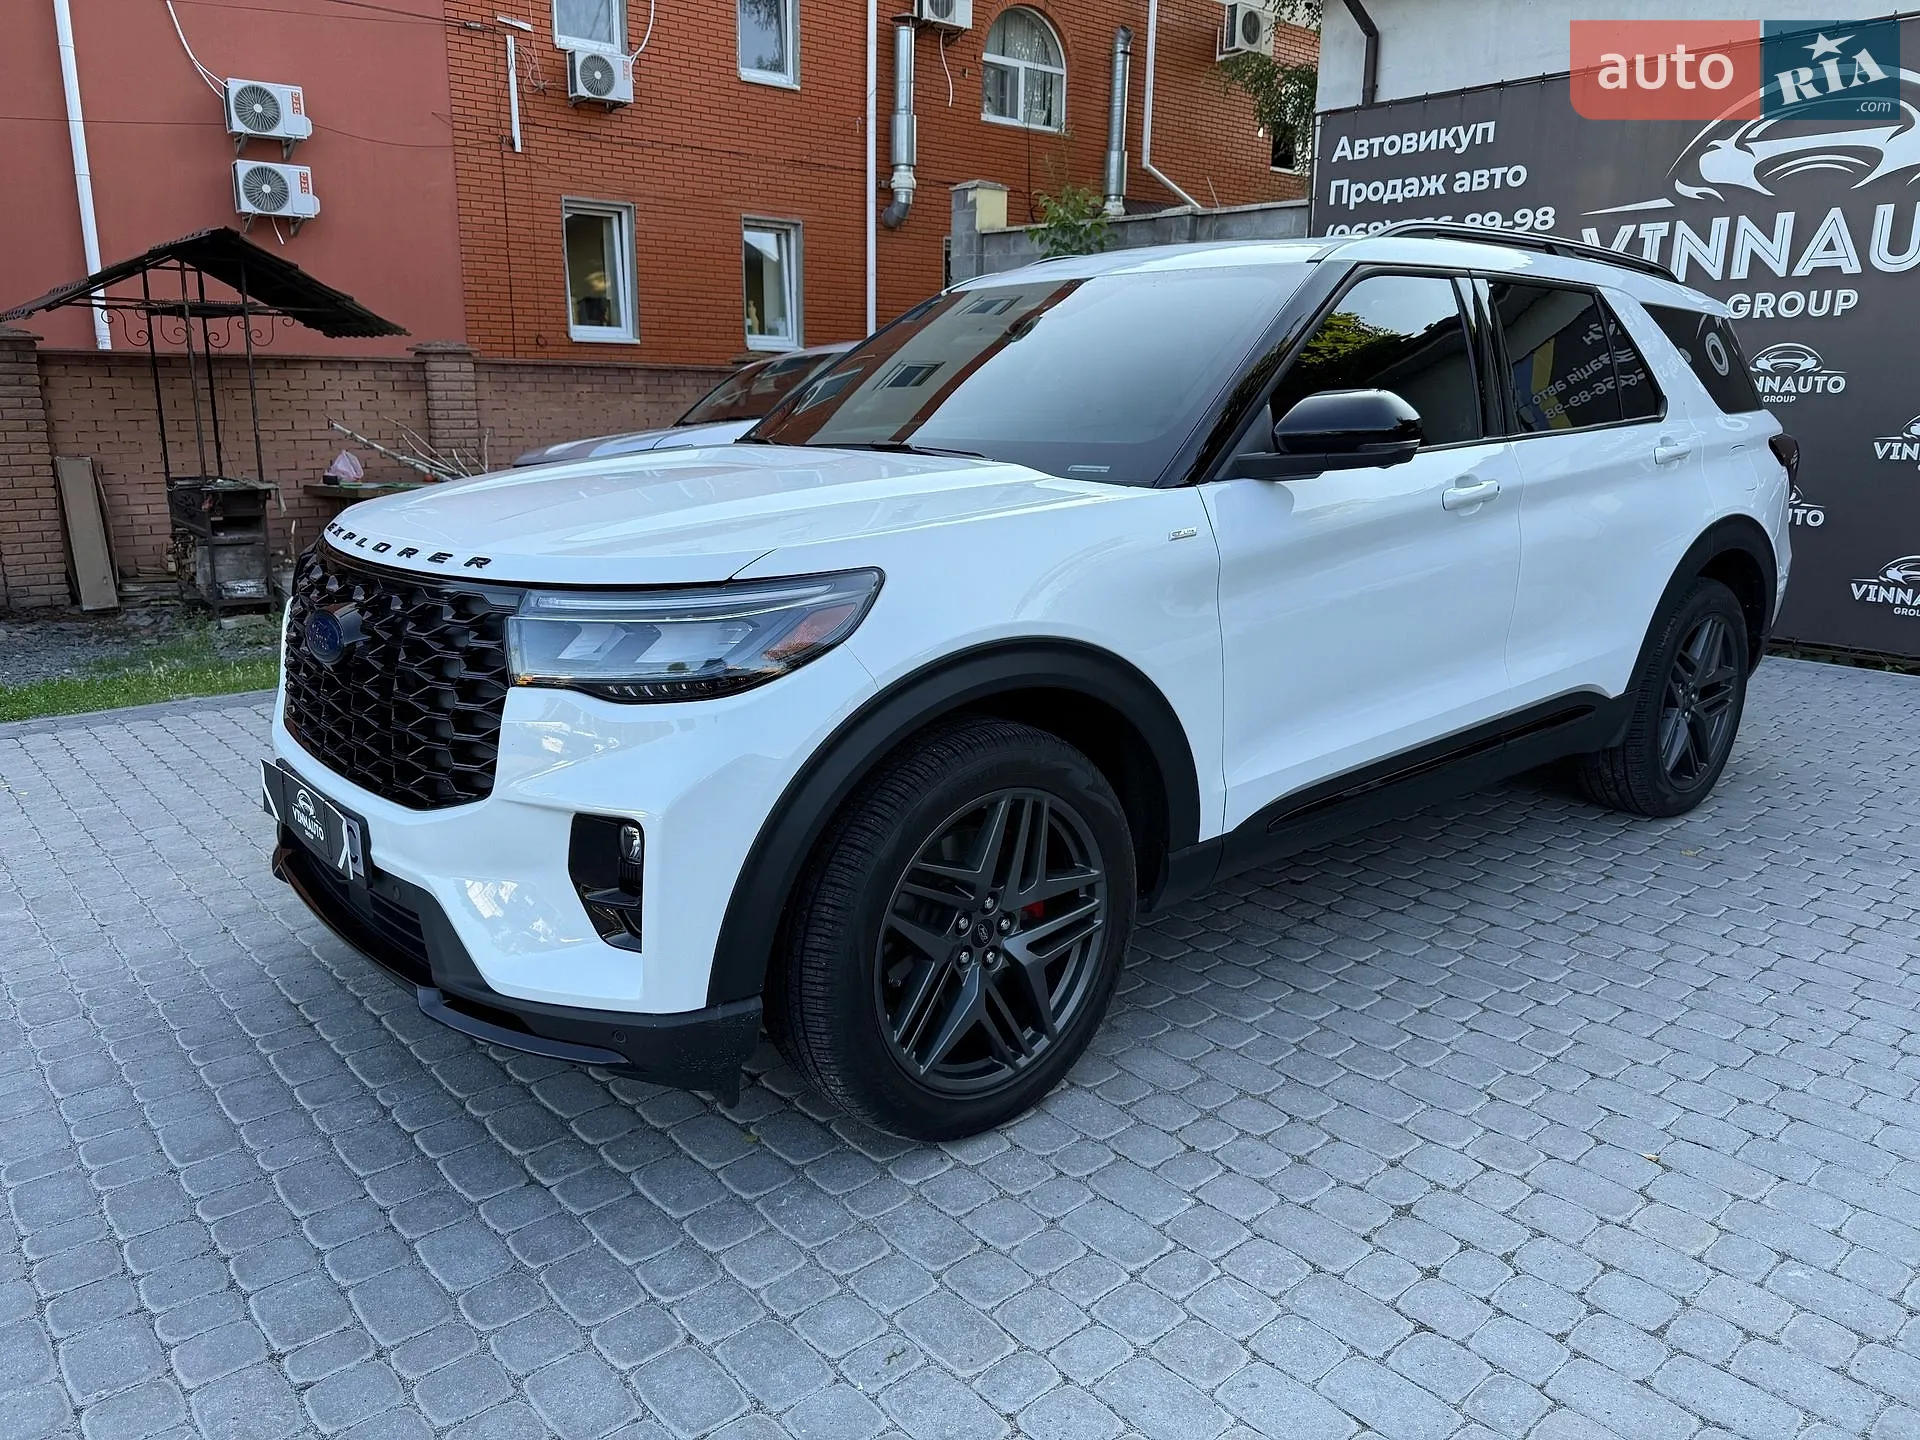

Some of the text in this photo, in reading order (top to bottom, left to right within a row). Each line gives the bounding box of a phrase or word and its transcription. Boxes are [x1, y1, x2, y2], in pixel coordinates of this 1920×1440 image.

[1331, 120, 1496, 163] Автовикуп
[1329, 164, 1528, 210] Продаж авто
[1726, 289, 1858, 320] GROUP
[1763, 395, 1797, 403] GROUP
[326, 522, 493, 569] EXPLORER
